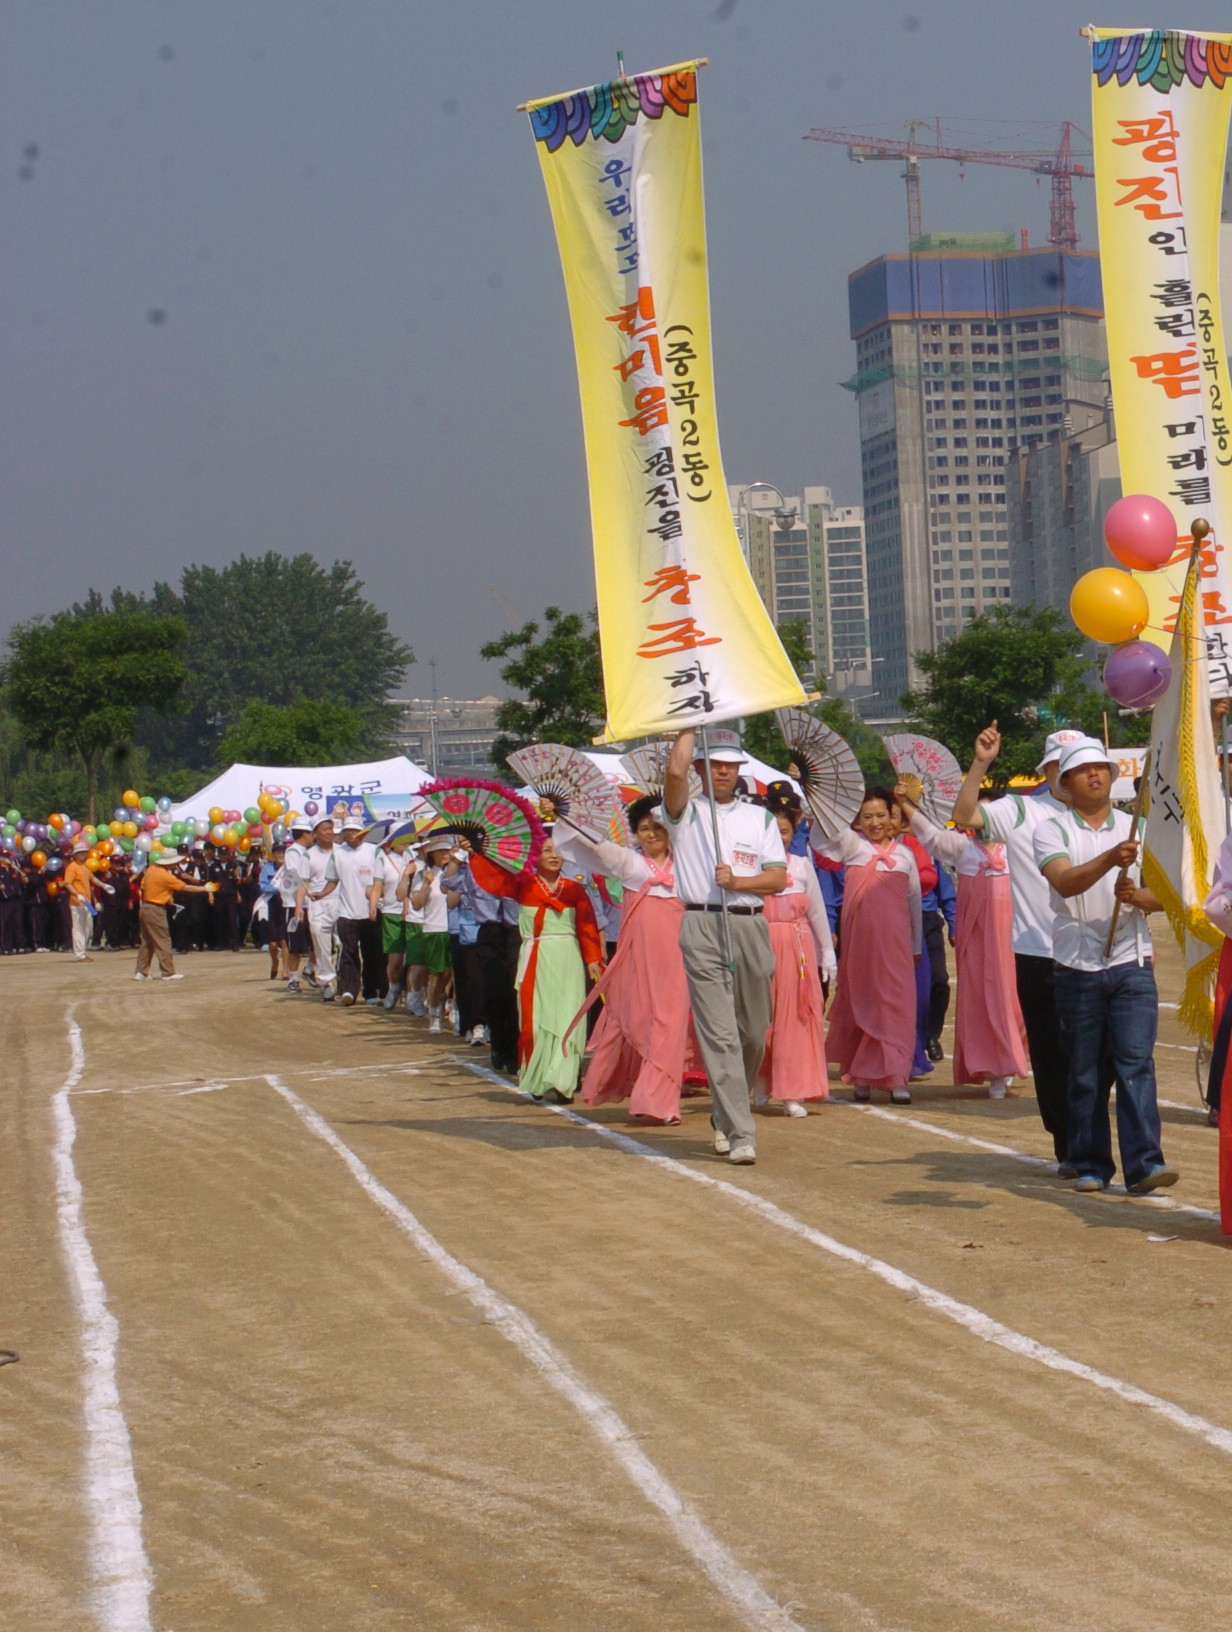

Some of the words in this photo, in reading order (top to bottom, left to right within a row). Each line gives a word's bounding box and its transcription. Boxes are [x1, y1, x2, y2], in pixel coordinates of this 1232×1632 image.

[663, 324, 713, 503] (중곡2동)
[1196, 292, 1232, 467] (중곡2동)
[301, 780, 382, 800] 영광군
